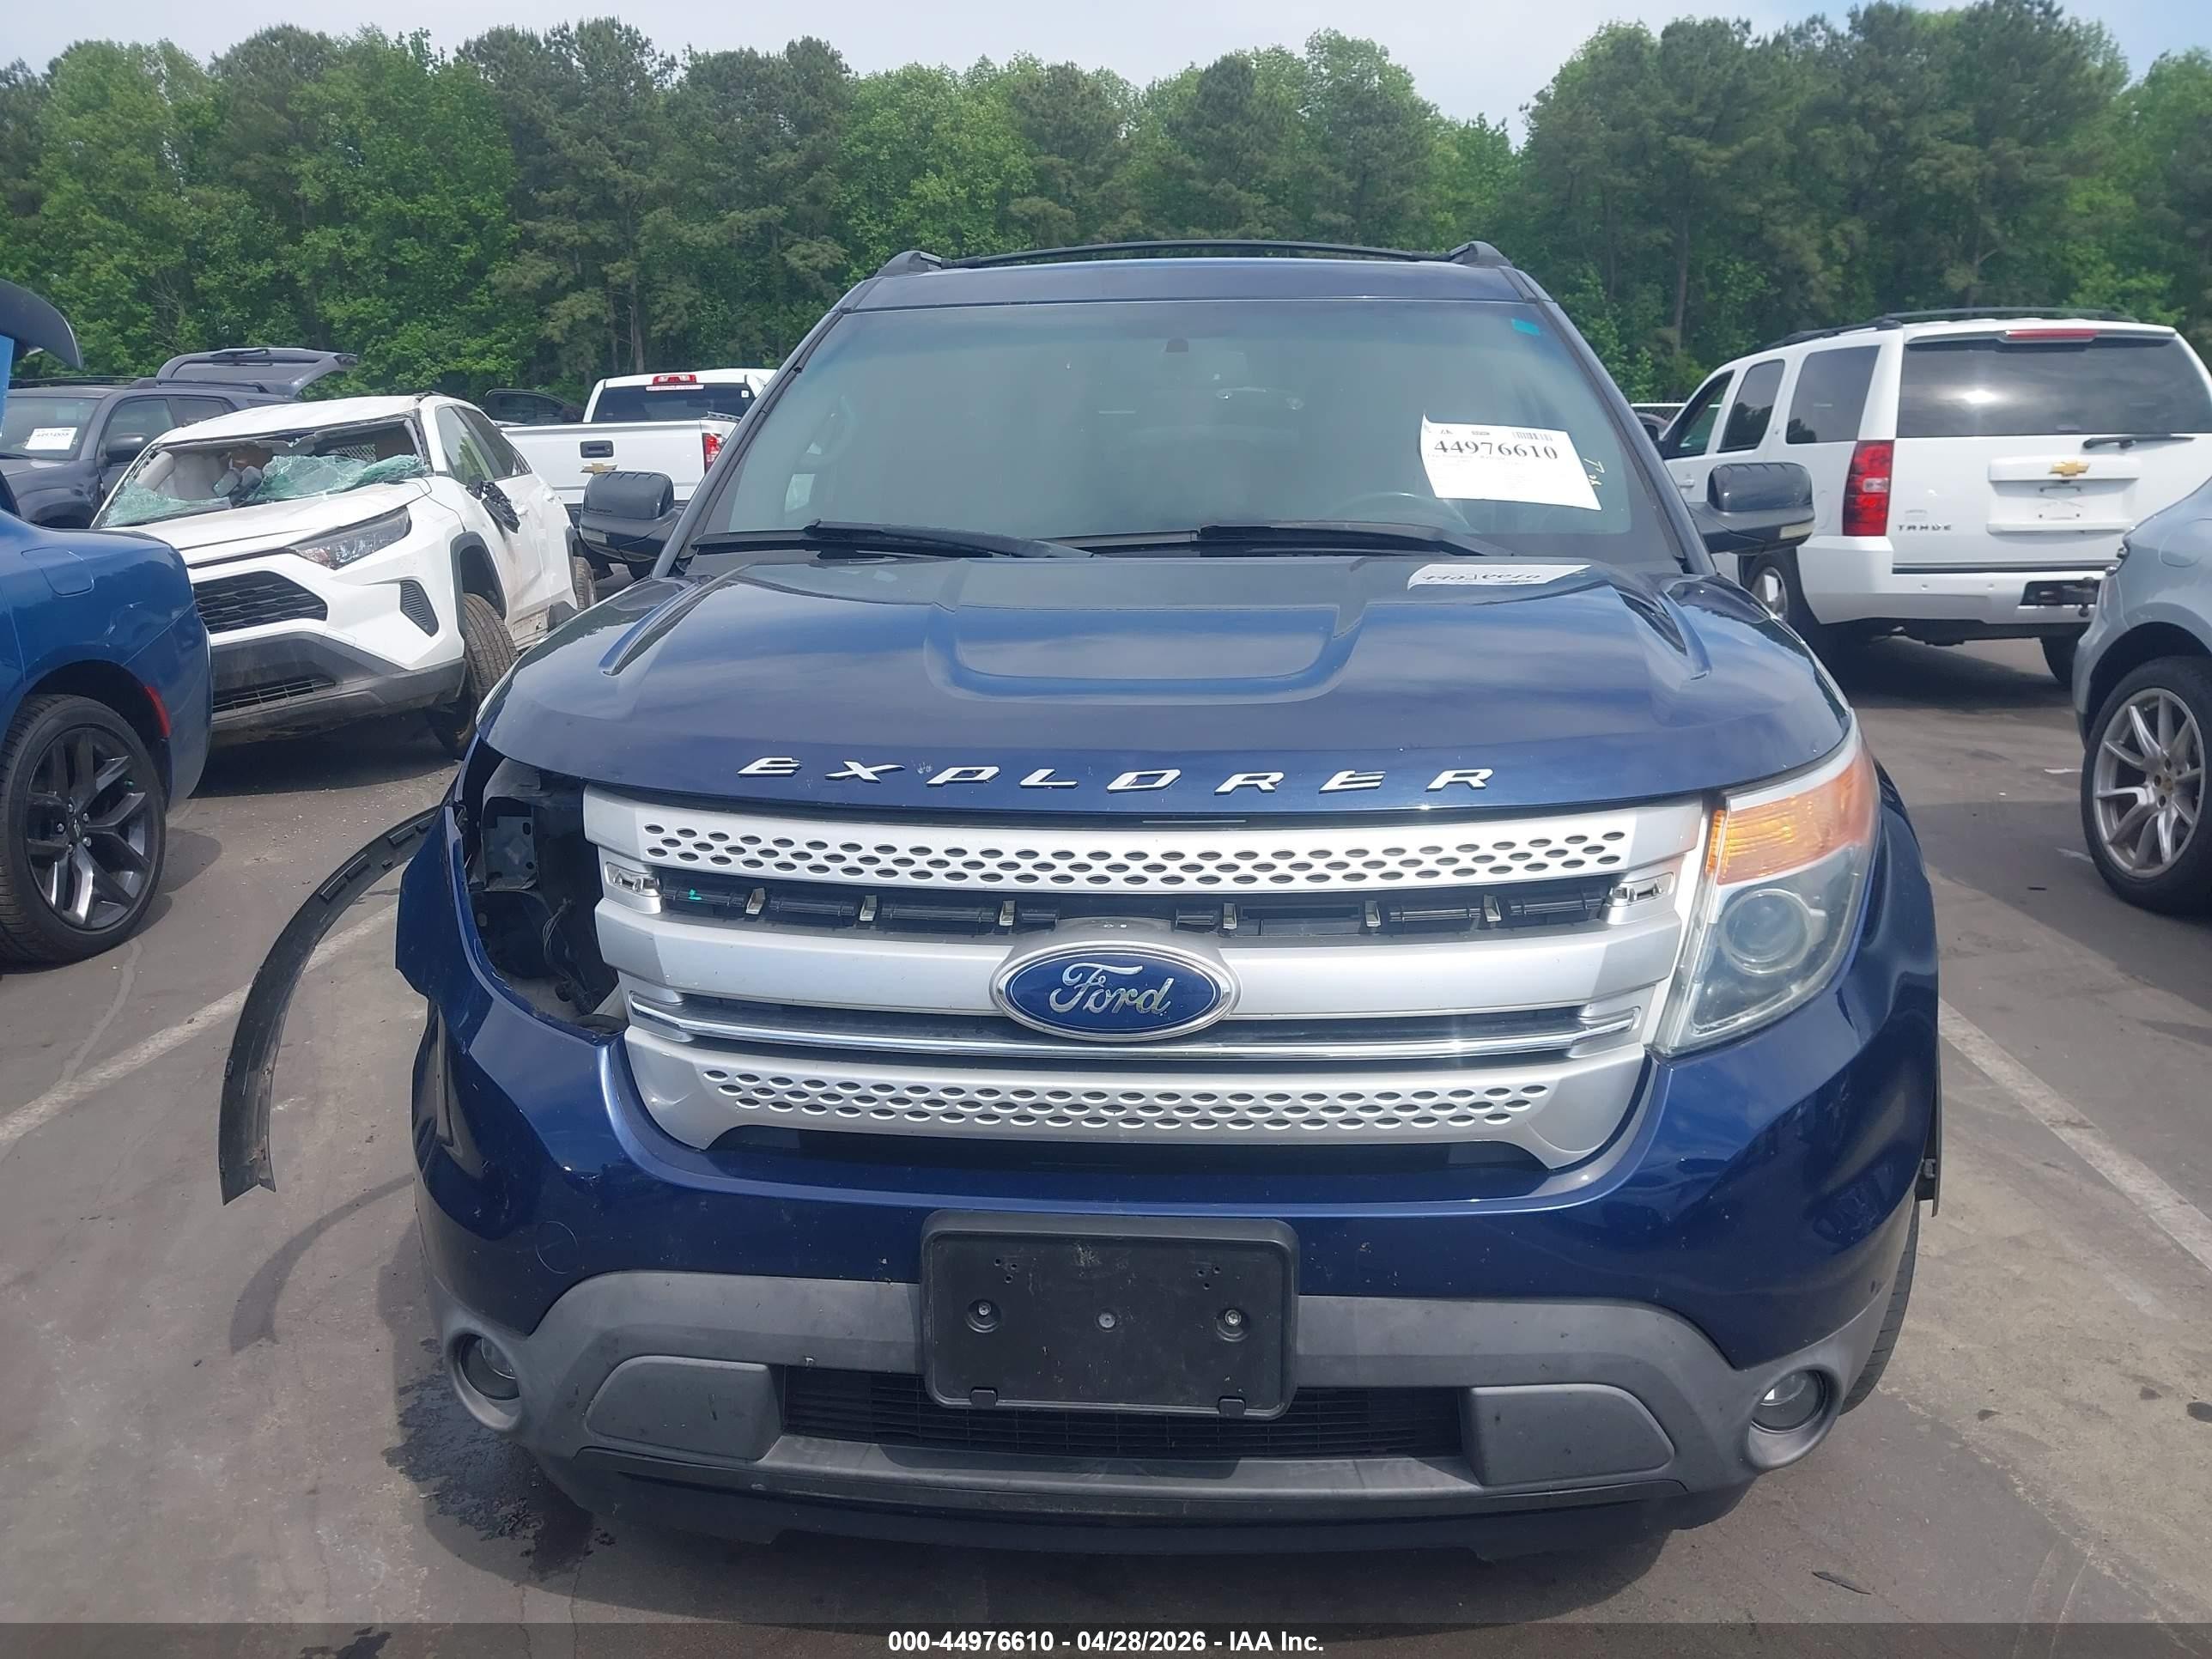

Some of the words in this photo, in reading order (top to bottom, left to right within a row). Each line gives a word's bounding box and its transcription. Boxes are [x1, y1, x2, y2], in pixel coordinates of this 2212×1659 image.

[1434, 440, 1559, 460] 44976610
[737, 757, 1494, 795] EXPLORER
[1049, 963, 1176, 1015] Ford
